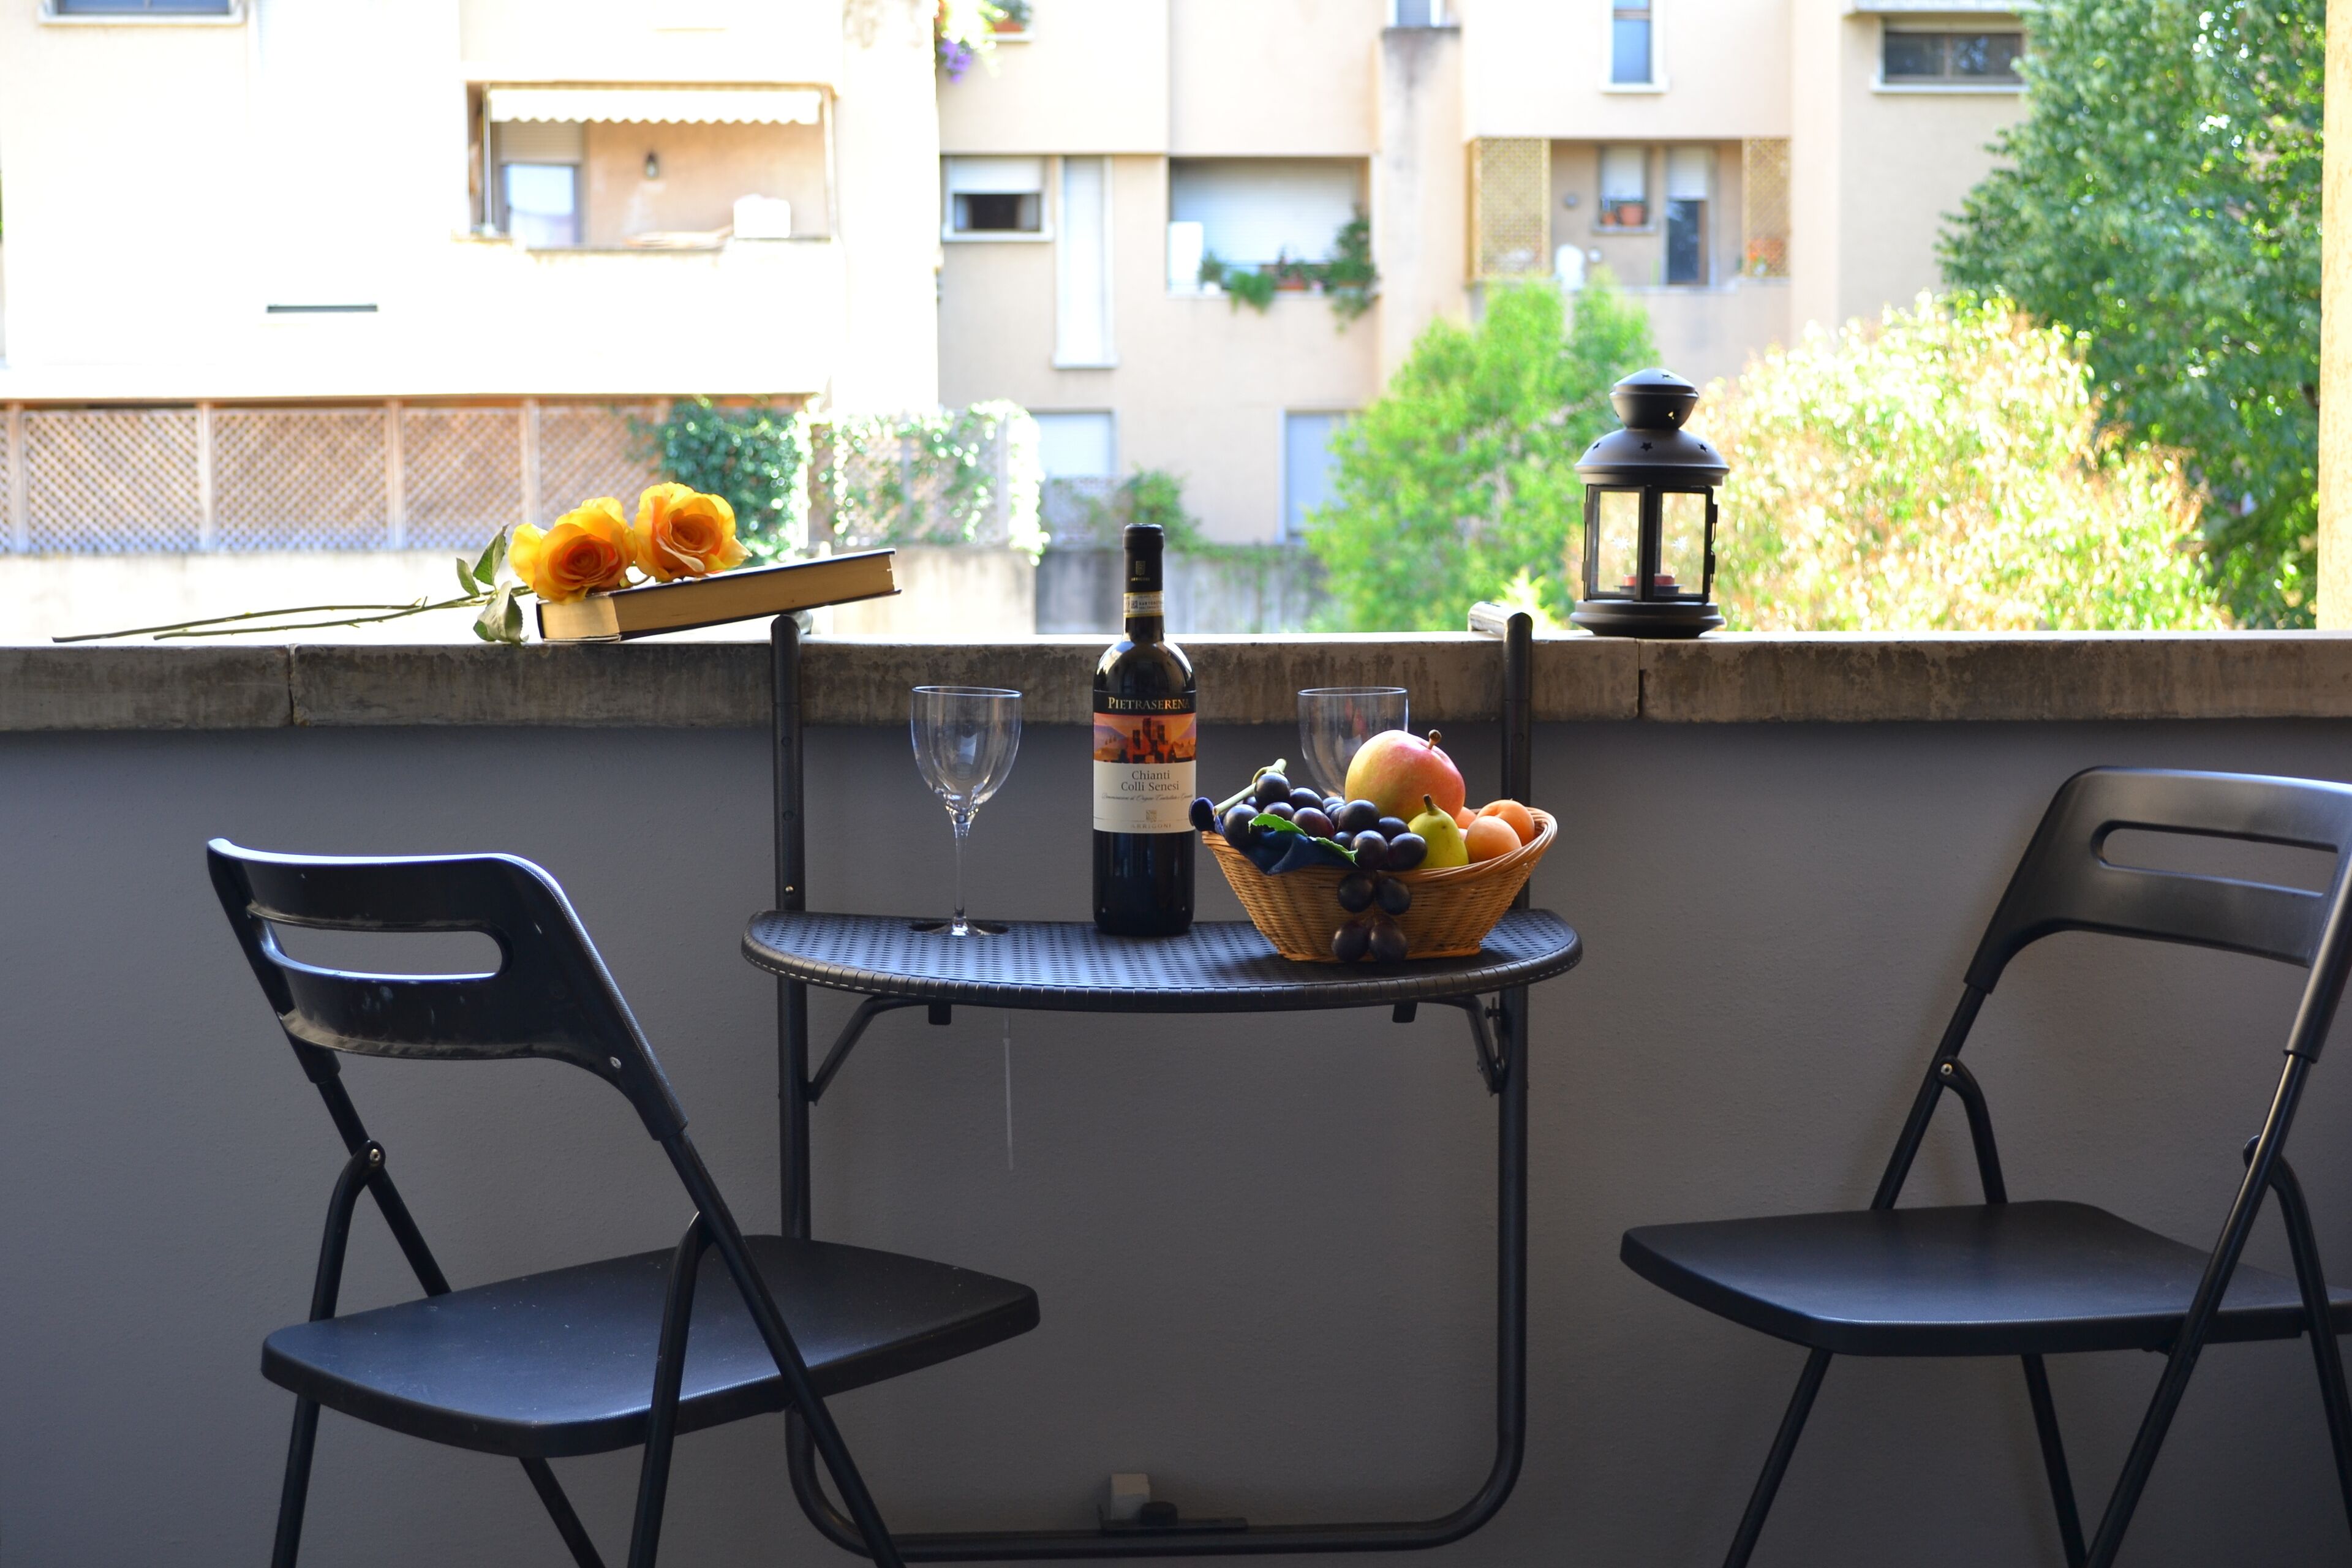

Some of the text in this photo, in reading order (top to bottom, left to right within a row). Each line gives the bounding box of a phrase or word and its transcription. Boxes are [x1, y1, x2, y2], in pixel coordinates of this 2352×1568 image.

[1107, 696, 1190, 710] PIETRASERENA
[1131, 770, 1170, 780] Chianti
[1121, 781, 1180, 791] Colli Senesi
